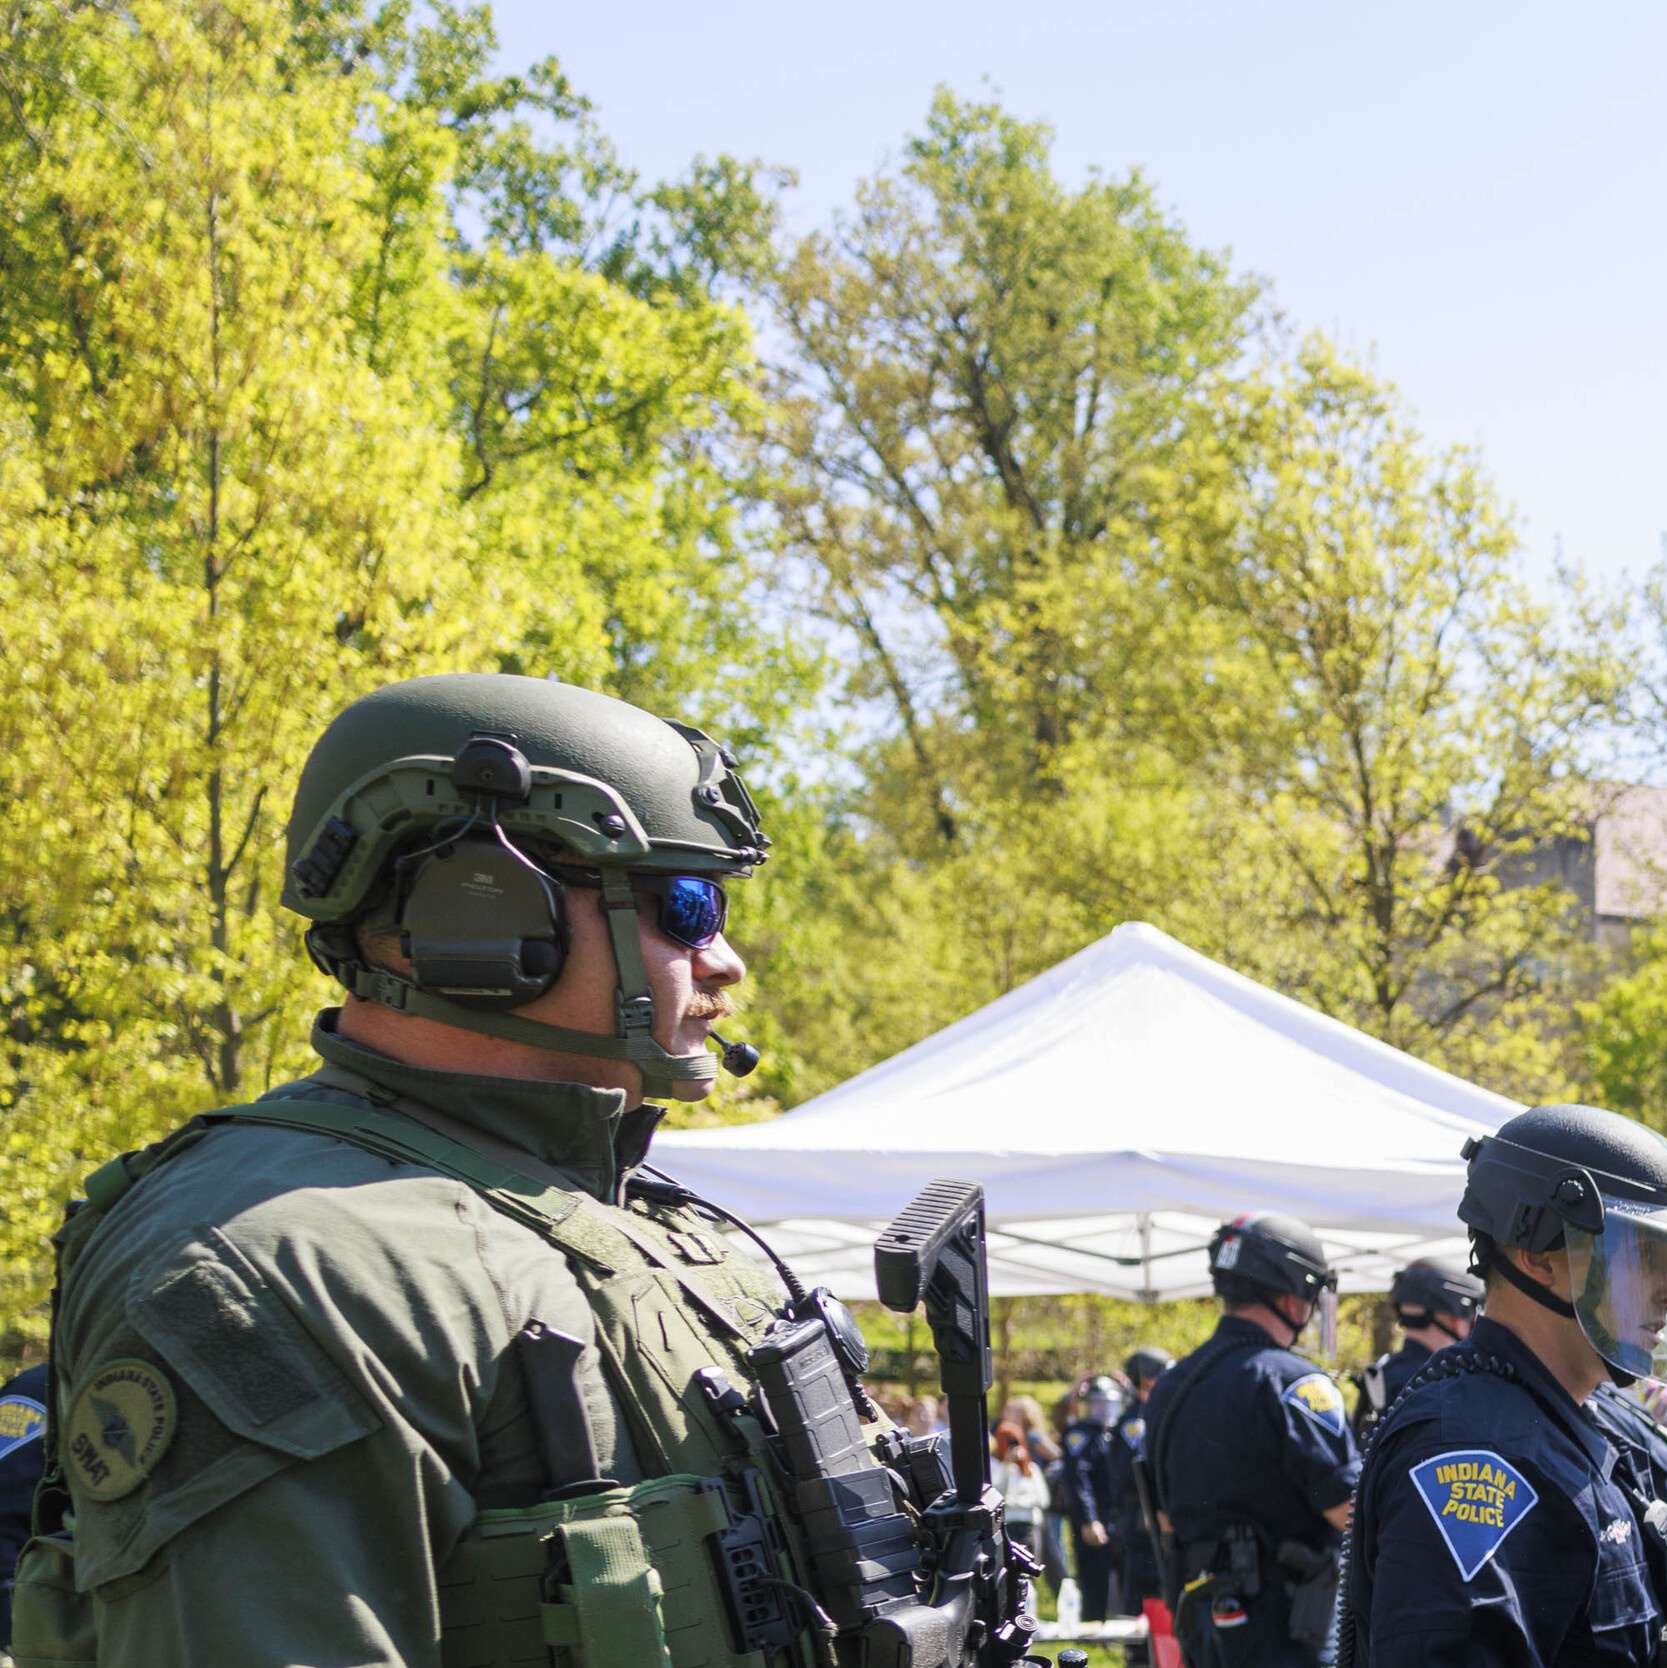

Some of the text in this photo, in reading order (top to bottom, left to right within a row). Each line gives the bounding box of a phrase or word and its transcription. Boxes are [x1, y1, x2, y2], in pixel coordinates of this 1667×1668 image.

[473, 872, 494, 885] 3M
[141, 1376, 166, 1411] STATE
[72, 1432, 110, 1486] SWAT
[1435, 1462, 1517, 1501] INDIANA
[1450, 1482, 1505, 1510] STATE
[1441, 1499, 1505, 1528] POLICE
